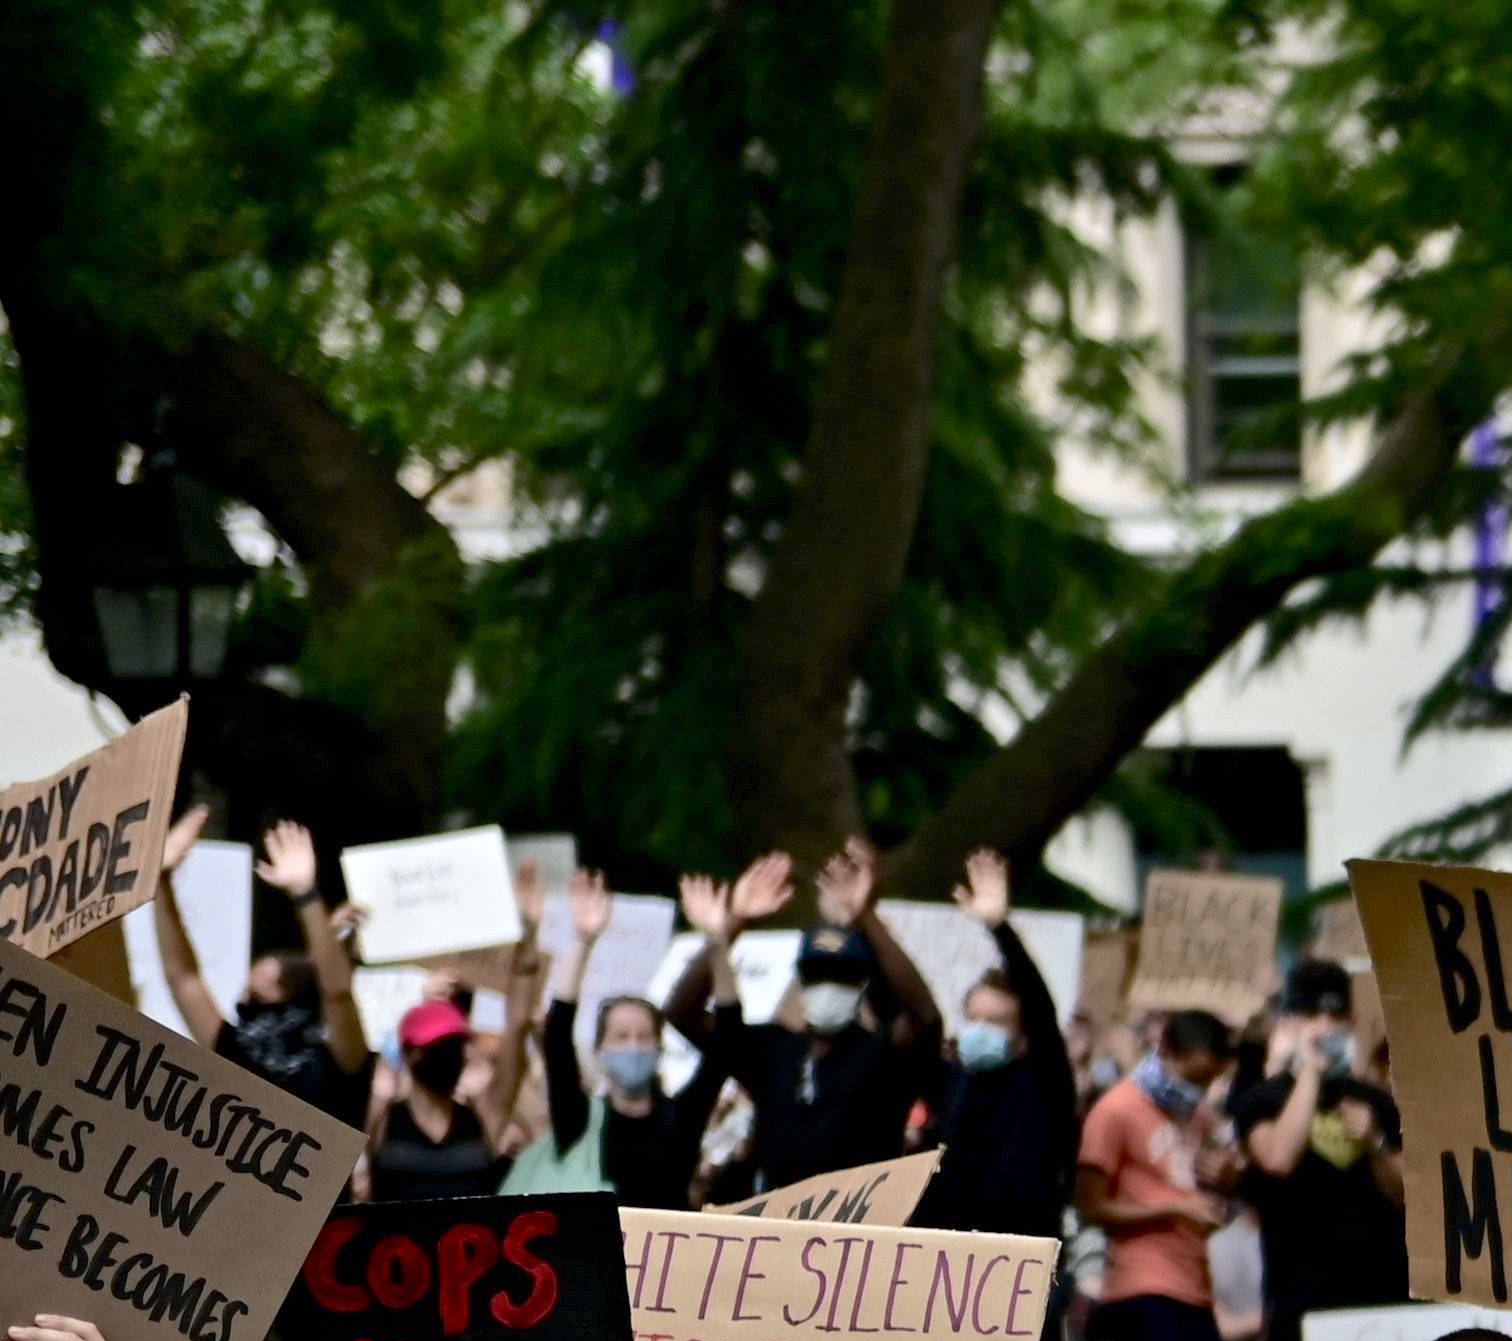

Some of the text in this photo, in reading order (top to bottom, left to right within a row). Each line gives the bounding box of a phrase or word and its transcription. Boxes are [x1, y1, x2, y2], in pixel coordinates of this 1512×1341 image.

[50, 896, 117, 942] MATTERED
[75, 1024, 322, 1201] INJUSTICE
[103, 1145, 225, 1236] LAW
[783, 1235, 1044, 1337] SILENCE
